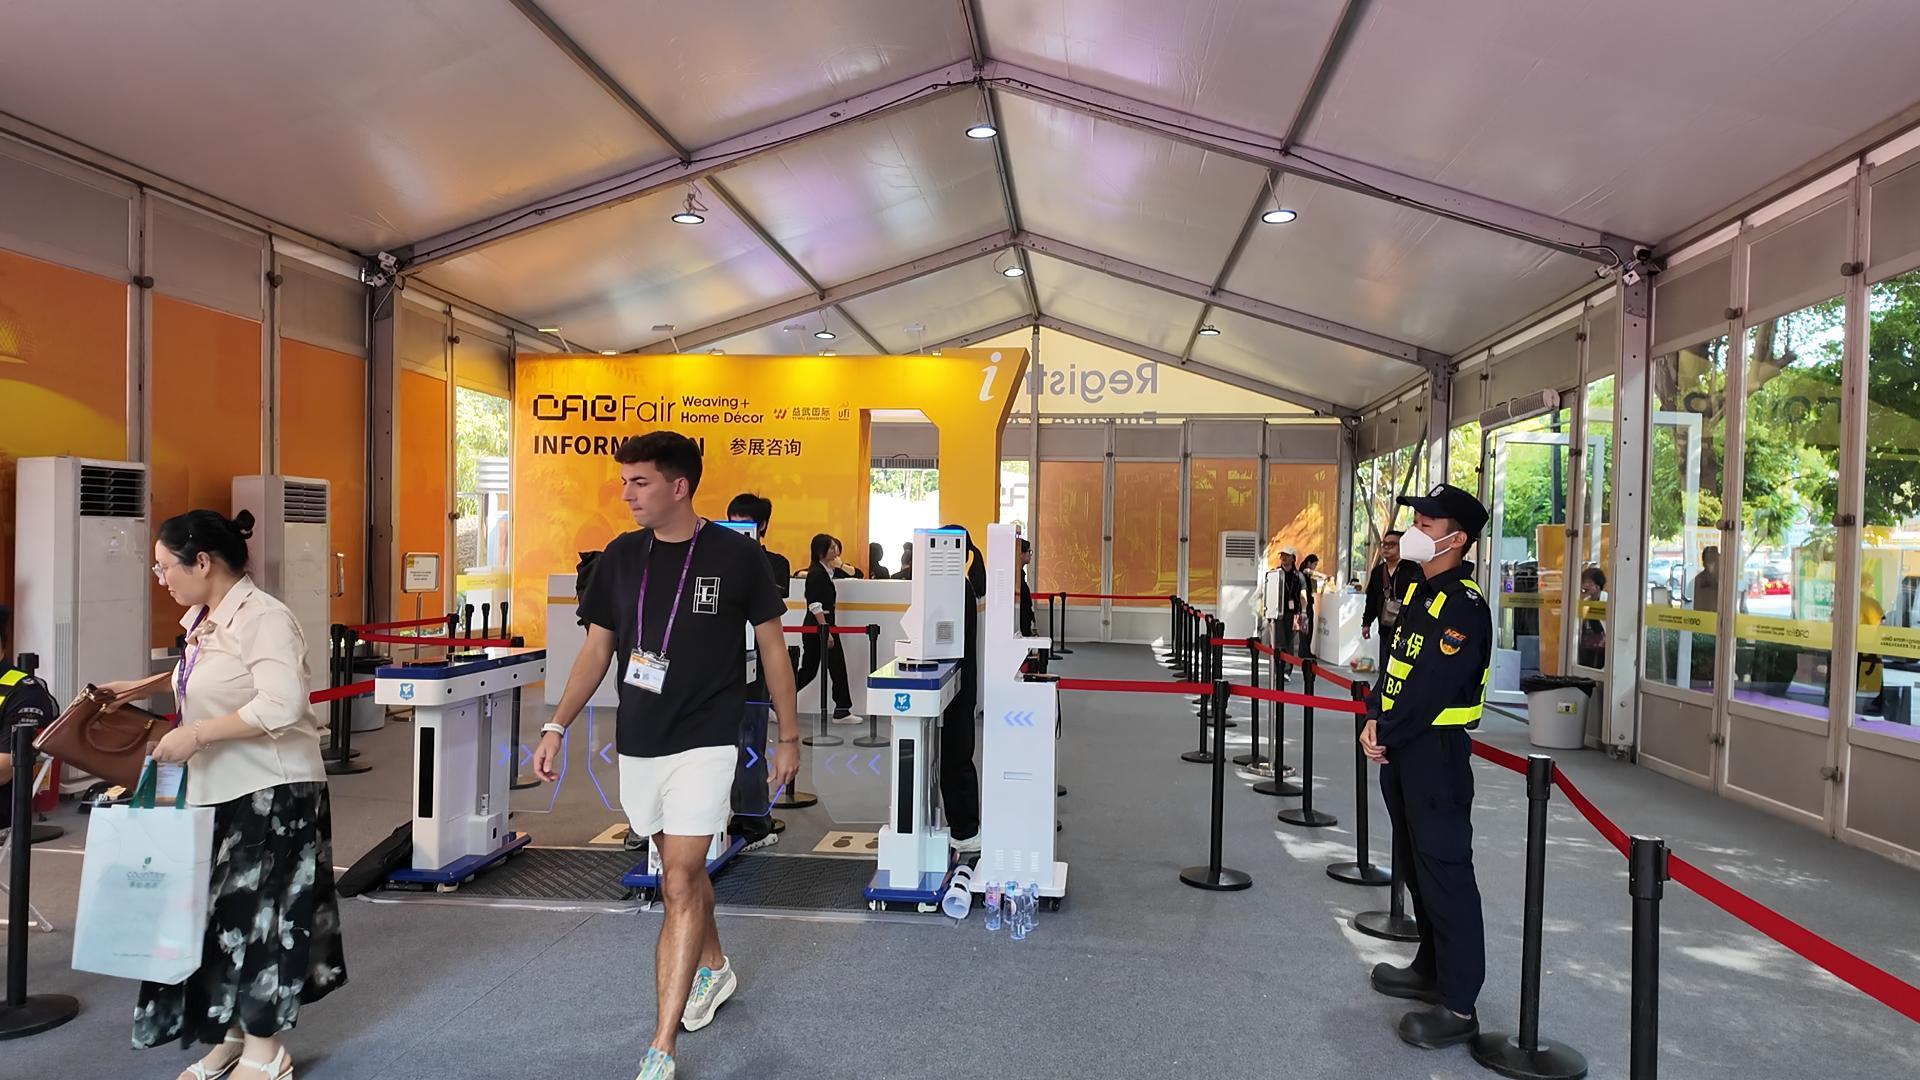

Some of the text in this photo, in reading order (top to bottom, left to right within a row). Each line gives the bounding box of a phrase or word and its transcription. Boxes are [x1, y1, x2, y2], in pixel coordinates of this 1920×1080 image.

[681, 410, 765, 424] Home Décor
[534, 435, 704, 456] INFORM
[730, 438, 802, 457] 参展咨询
